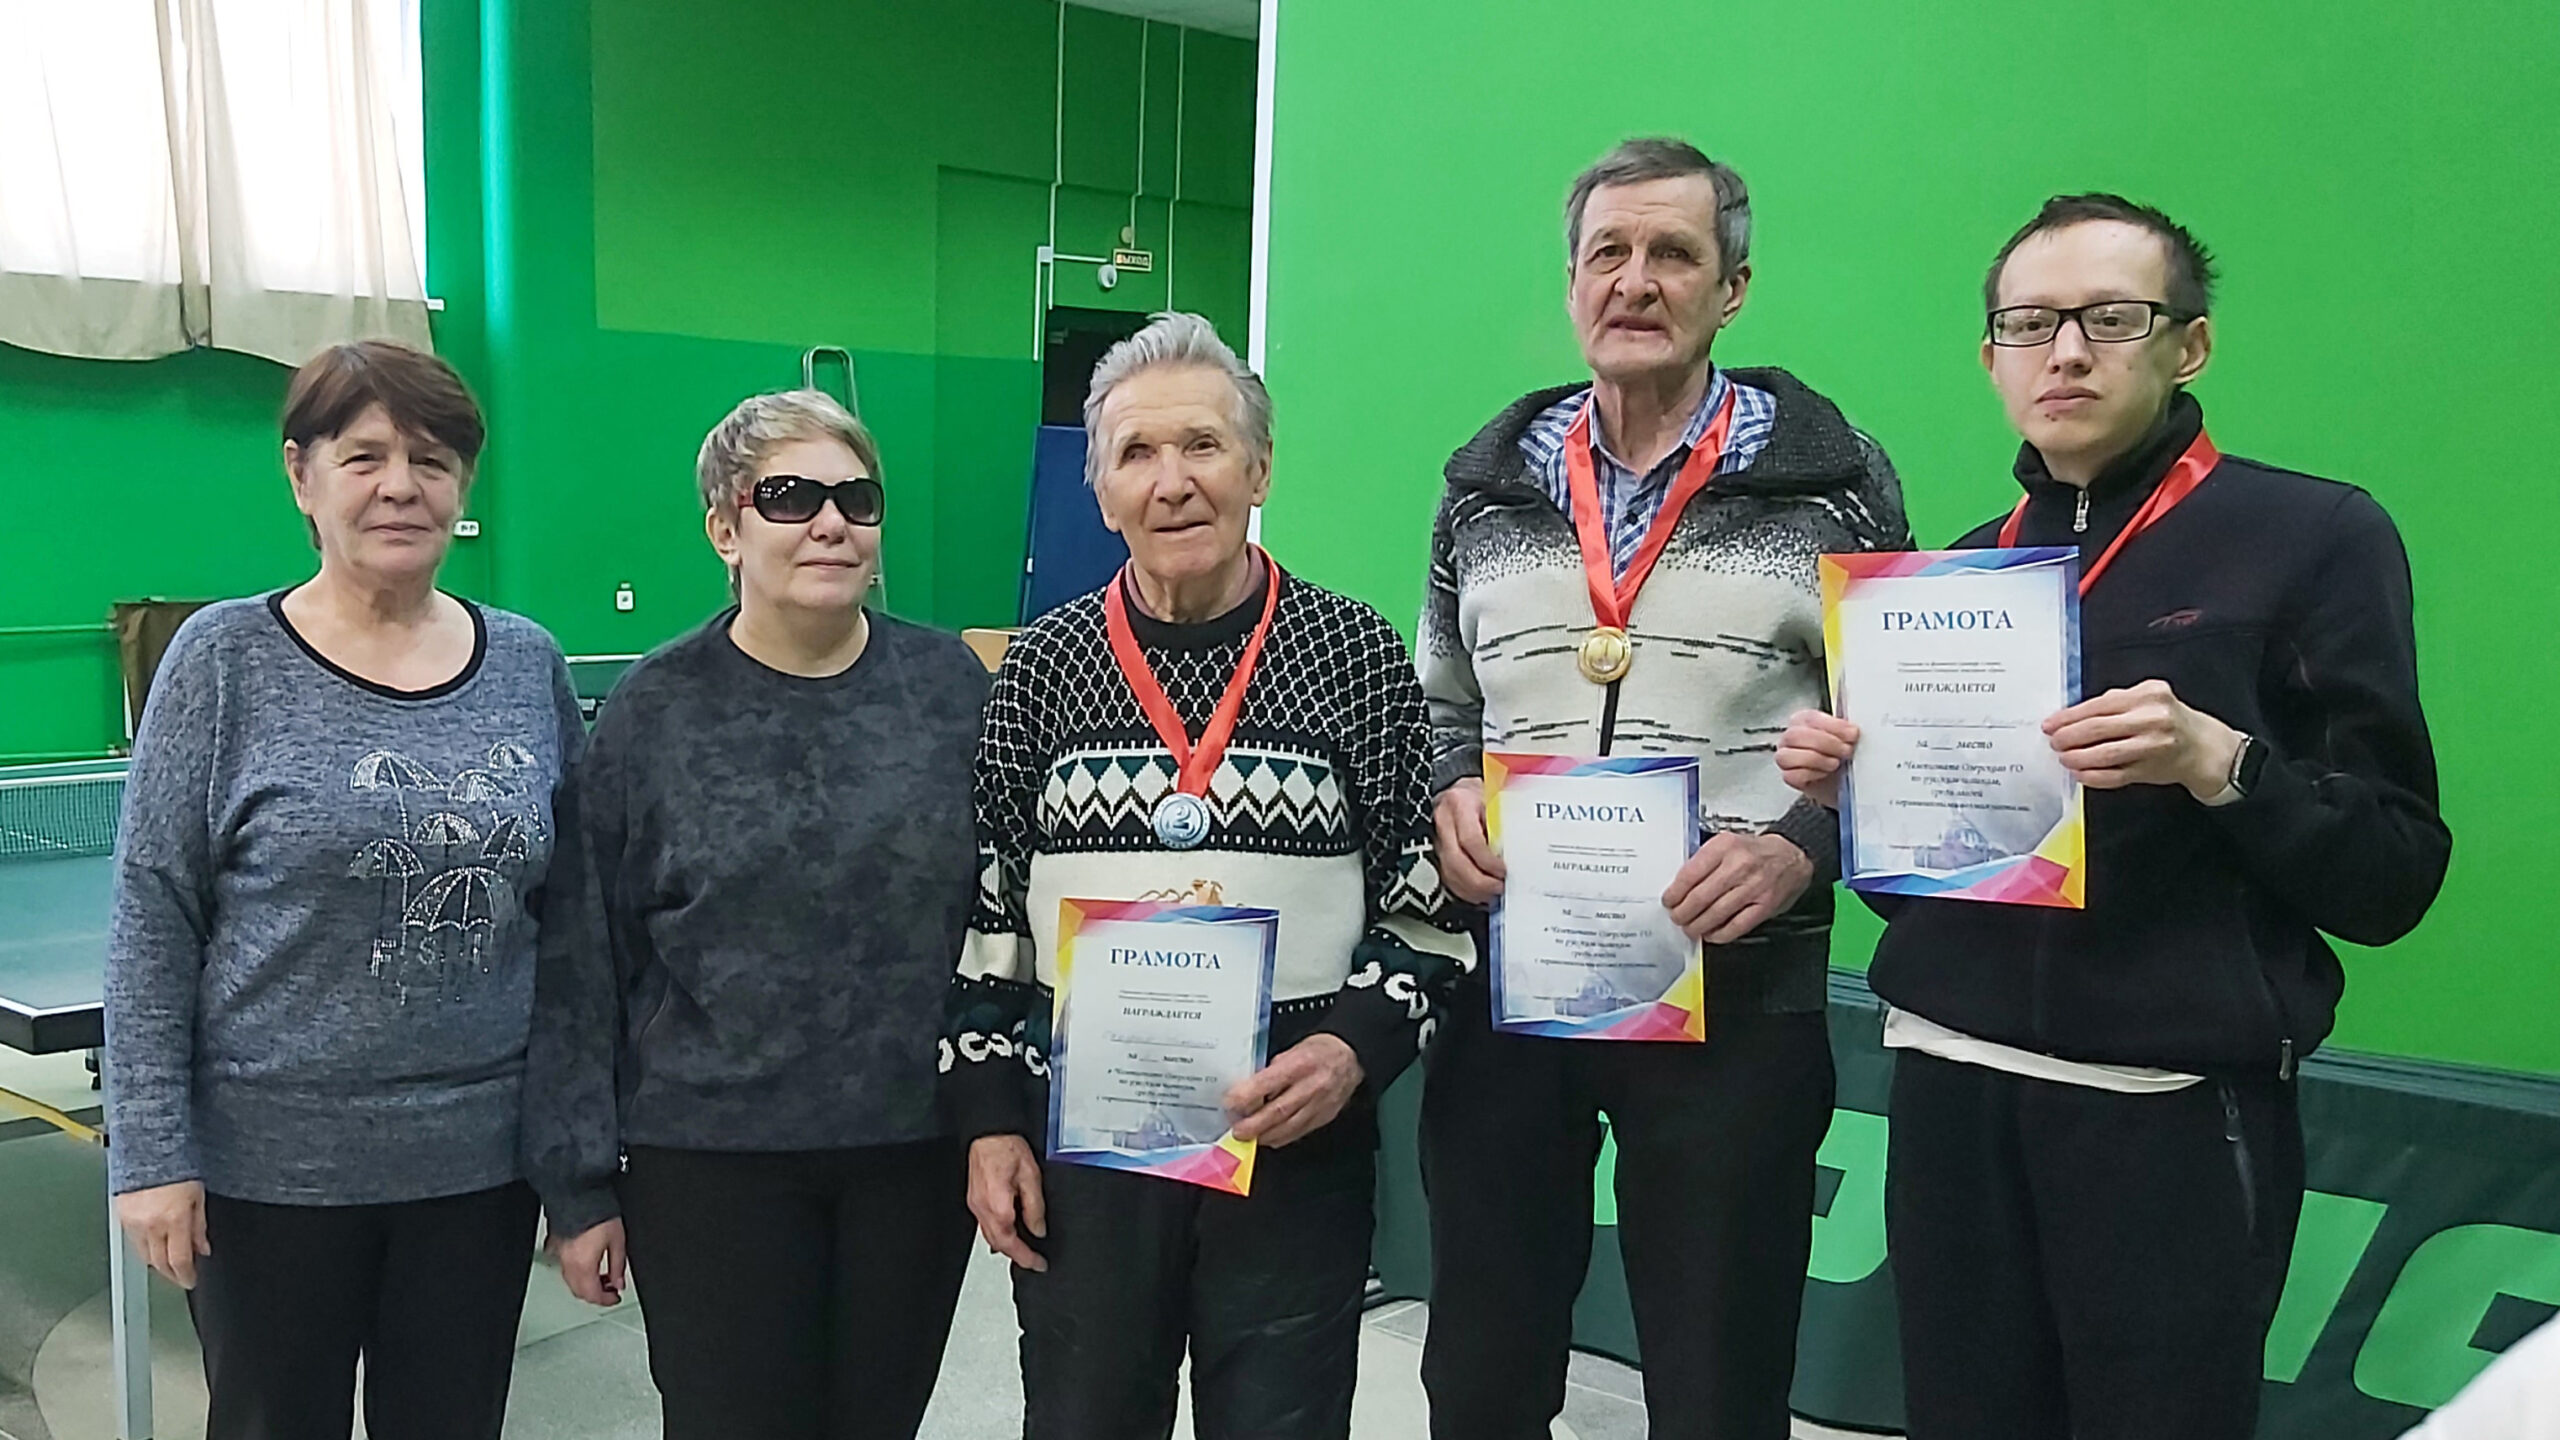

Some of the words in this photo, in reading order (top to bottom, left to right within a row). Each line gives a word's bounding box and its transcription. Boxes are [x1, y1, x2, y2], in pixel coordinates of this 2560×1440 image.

[1881, 610, 2014, 631] ГРАМОТА
[1904, 682, 1996, 693] НАГРАЖДАЕТСЯ
[1956, 741, 1993, 749] место
[1173, 805, 1191, 830] 2
[1535, 803, 1645, 822] ГРАМОТА
[1553, 862, 1629, 875] НАГРАЖДАЕТСЯ
[1109, 948, 1222, 970] ГРАМОТА
[1123, 1006, 1202, 1020] НАГРАЖДАЕТСЯ
